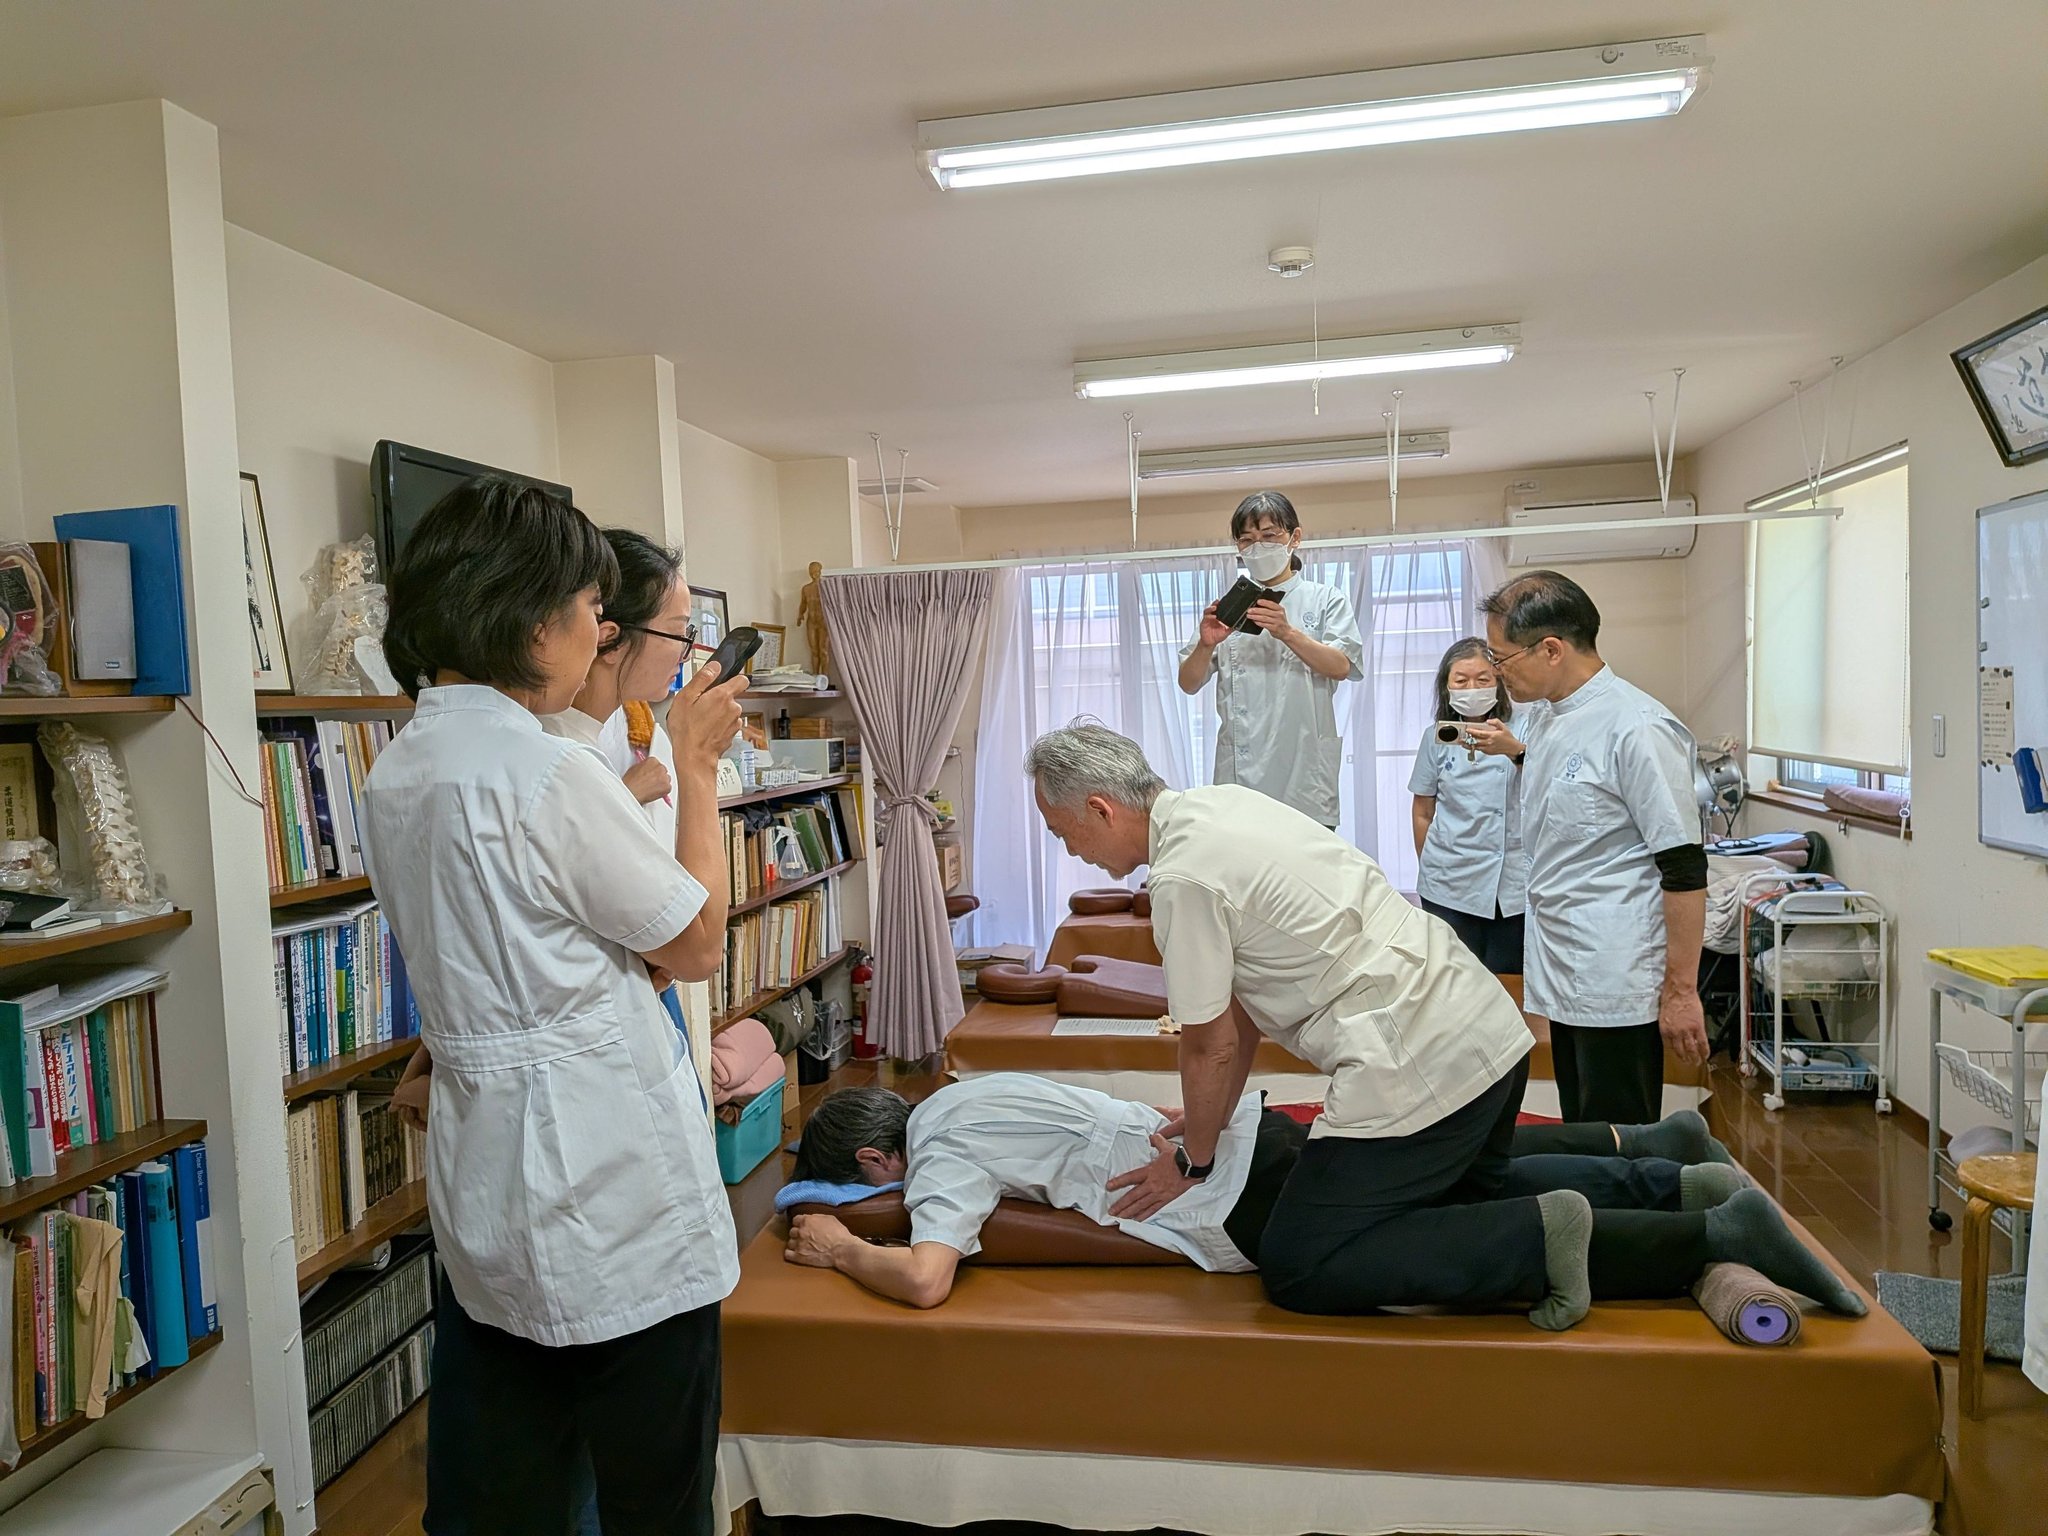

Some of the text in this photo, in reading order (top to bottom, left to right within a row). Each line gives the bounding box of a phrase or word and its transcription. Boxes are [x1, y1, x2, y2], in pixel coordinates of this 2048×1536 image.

[4, 786, 16, 840] 柔道整復師
